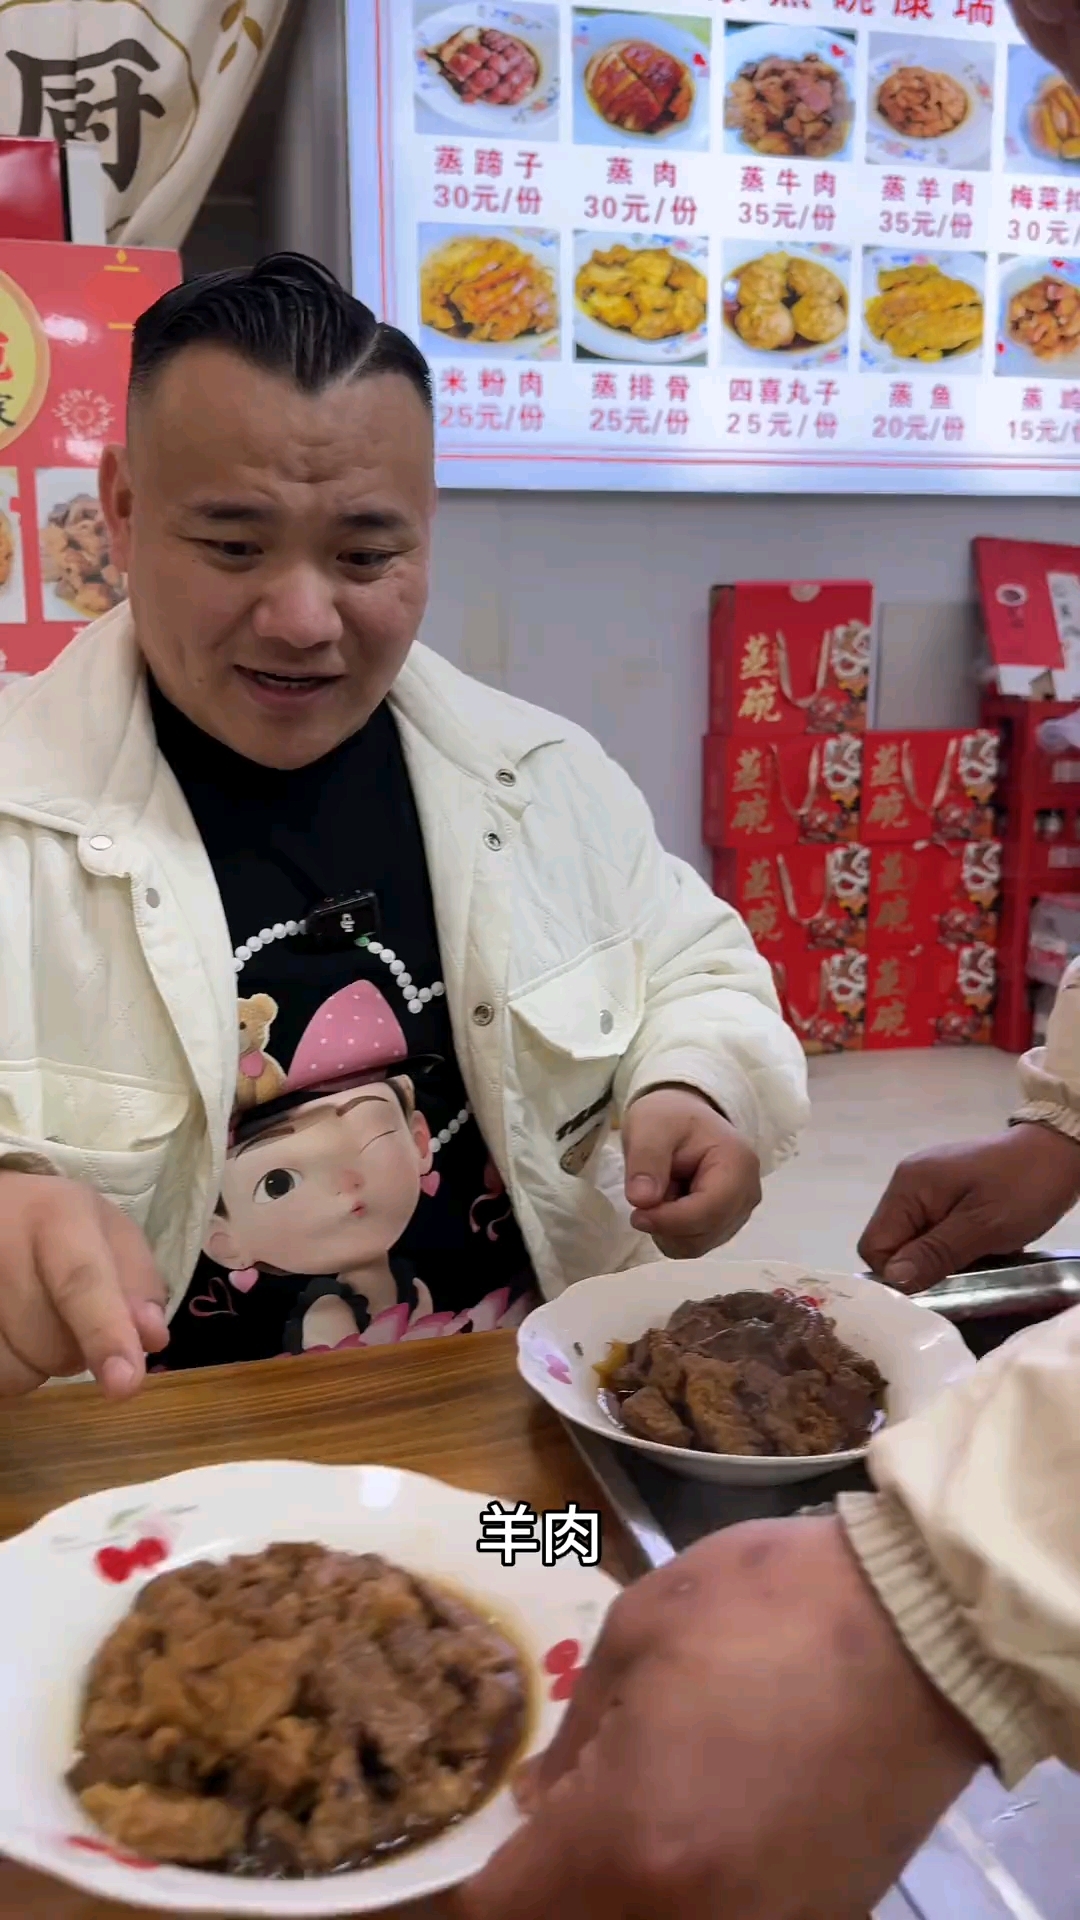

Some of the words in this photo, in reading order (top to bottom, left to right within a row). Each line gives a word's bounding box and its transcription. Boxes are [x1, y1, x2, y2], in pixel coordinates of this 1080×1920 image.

[5, 38, 166, 192] 厨
[434, 145, 543, 180] 蒸蹄子
[606, 156, 677, 188] 蒸肉
[740, 165, 837, 199] 蒸牛肉
[881, 174, 975, 207] 蒸羊肉
[433, 184, 543, 215] 30元/份
[584, 194, 698, 226] 30元/份
[738, 201, 837, 232] 35元/份
[879, 210, 974, 240] 35元/份
[440, 367, 544, 398] 米粉肉
[591, 371, 691, 403] 蒸排骨
[729, 376, 839, 406] 四喜丸子
[888, 381, 952, 410] 蒸鱼
[439, 403, 544, 432] 25元/份
[589, 407, 690, 435] 25元/份
[726, 411, 839, 440] 25元/份
[872, 415, 965, 442] 20元/份
[738, 632, 782, 723] 蒸碗
